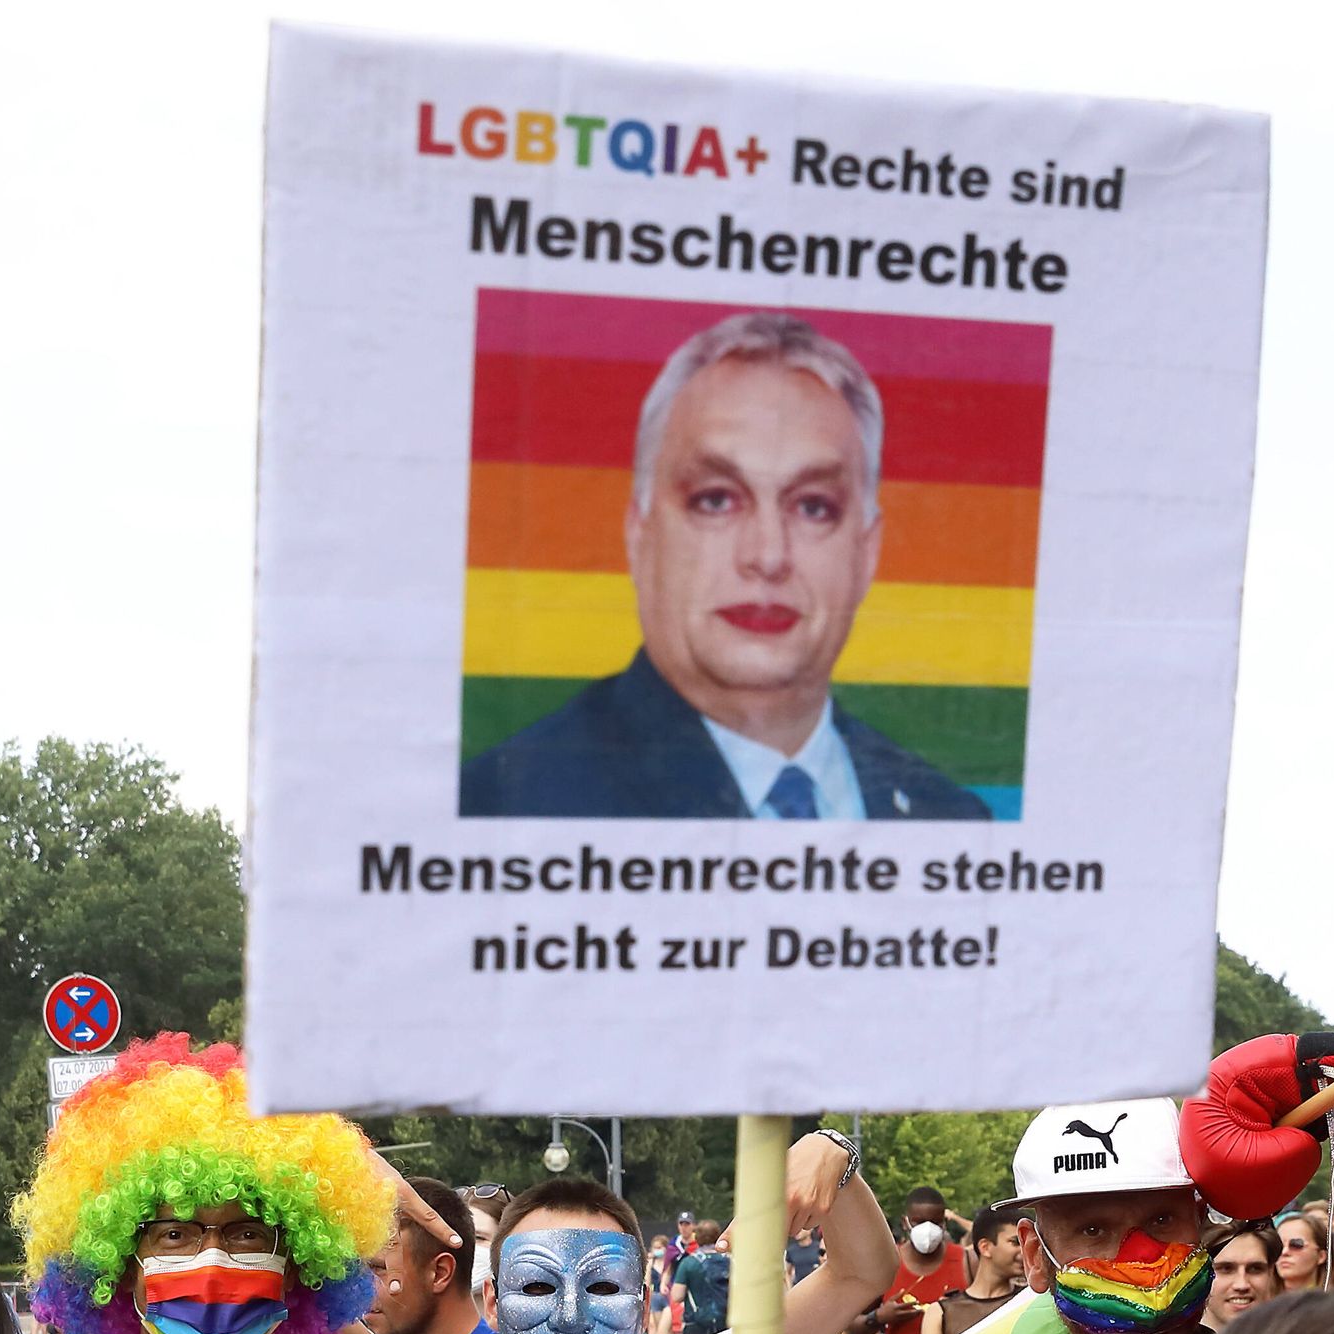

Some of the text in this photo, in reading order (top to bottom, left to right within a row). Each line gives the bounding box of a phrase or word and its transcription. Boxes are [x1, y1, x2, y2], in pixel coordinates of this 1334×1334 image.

[418, 103, 1125, 211] LGBTQIA+ Rechte sind
[470, 195, 1068, 294] Menschenrechte
[361, 845, 1103, 893] Menschenrechte stehen
[473, 924, 998, 971] nicht zur Debatte!
[1053, 1151, 1107, 1174] PUMA
